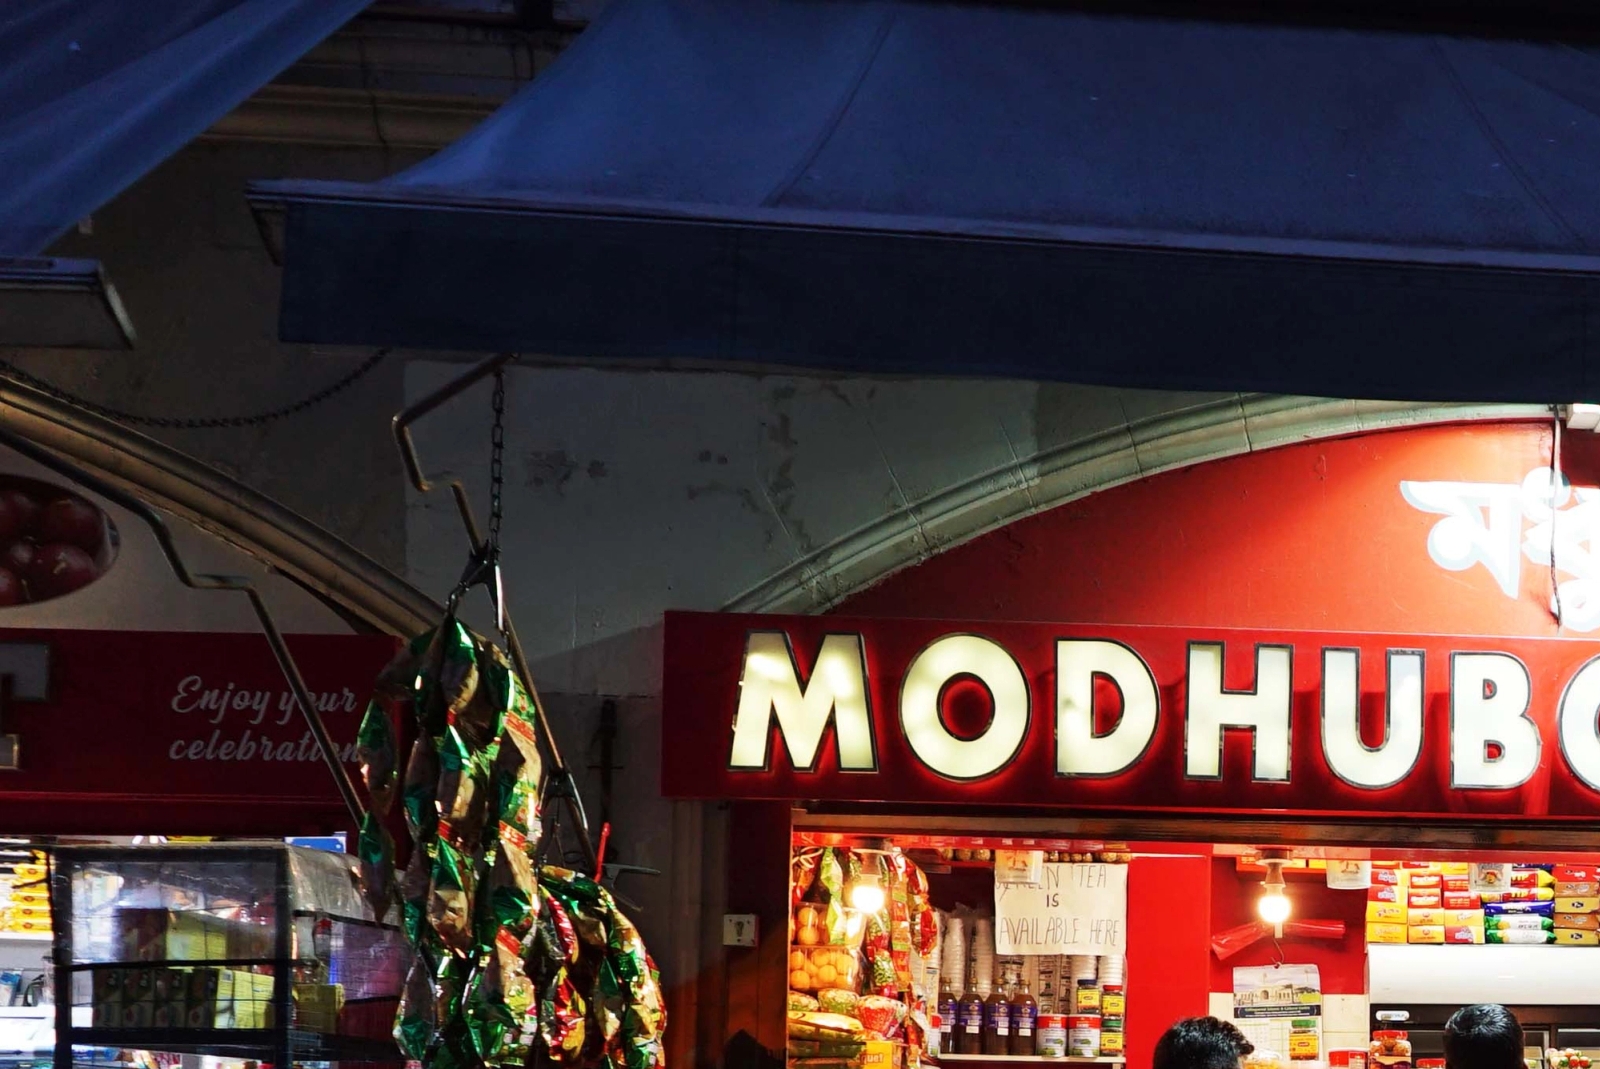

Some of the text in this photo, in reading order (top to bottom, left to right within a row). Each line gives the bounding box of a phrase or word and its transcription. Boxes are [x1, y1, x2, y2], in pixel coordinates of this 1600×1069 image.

[171, 675, 271, 725] Enjoy
[1046, 893, 1060, 908] IS
[1000, 917, 1120, 946] AVAILABLE HERE
